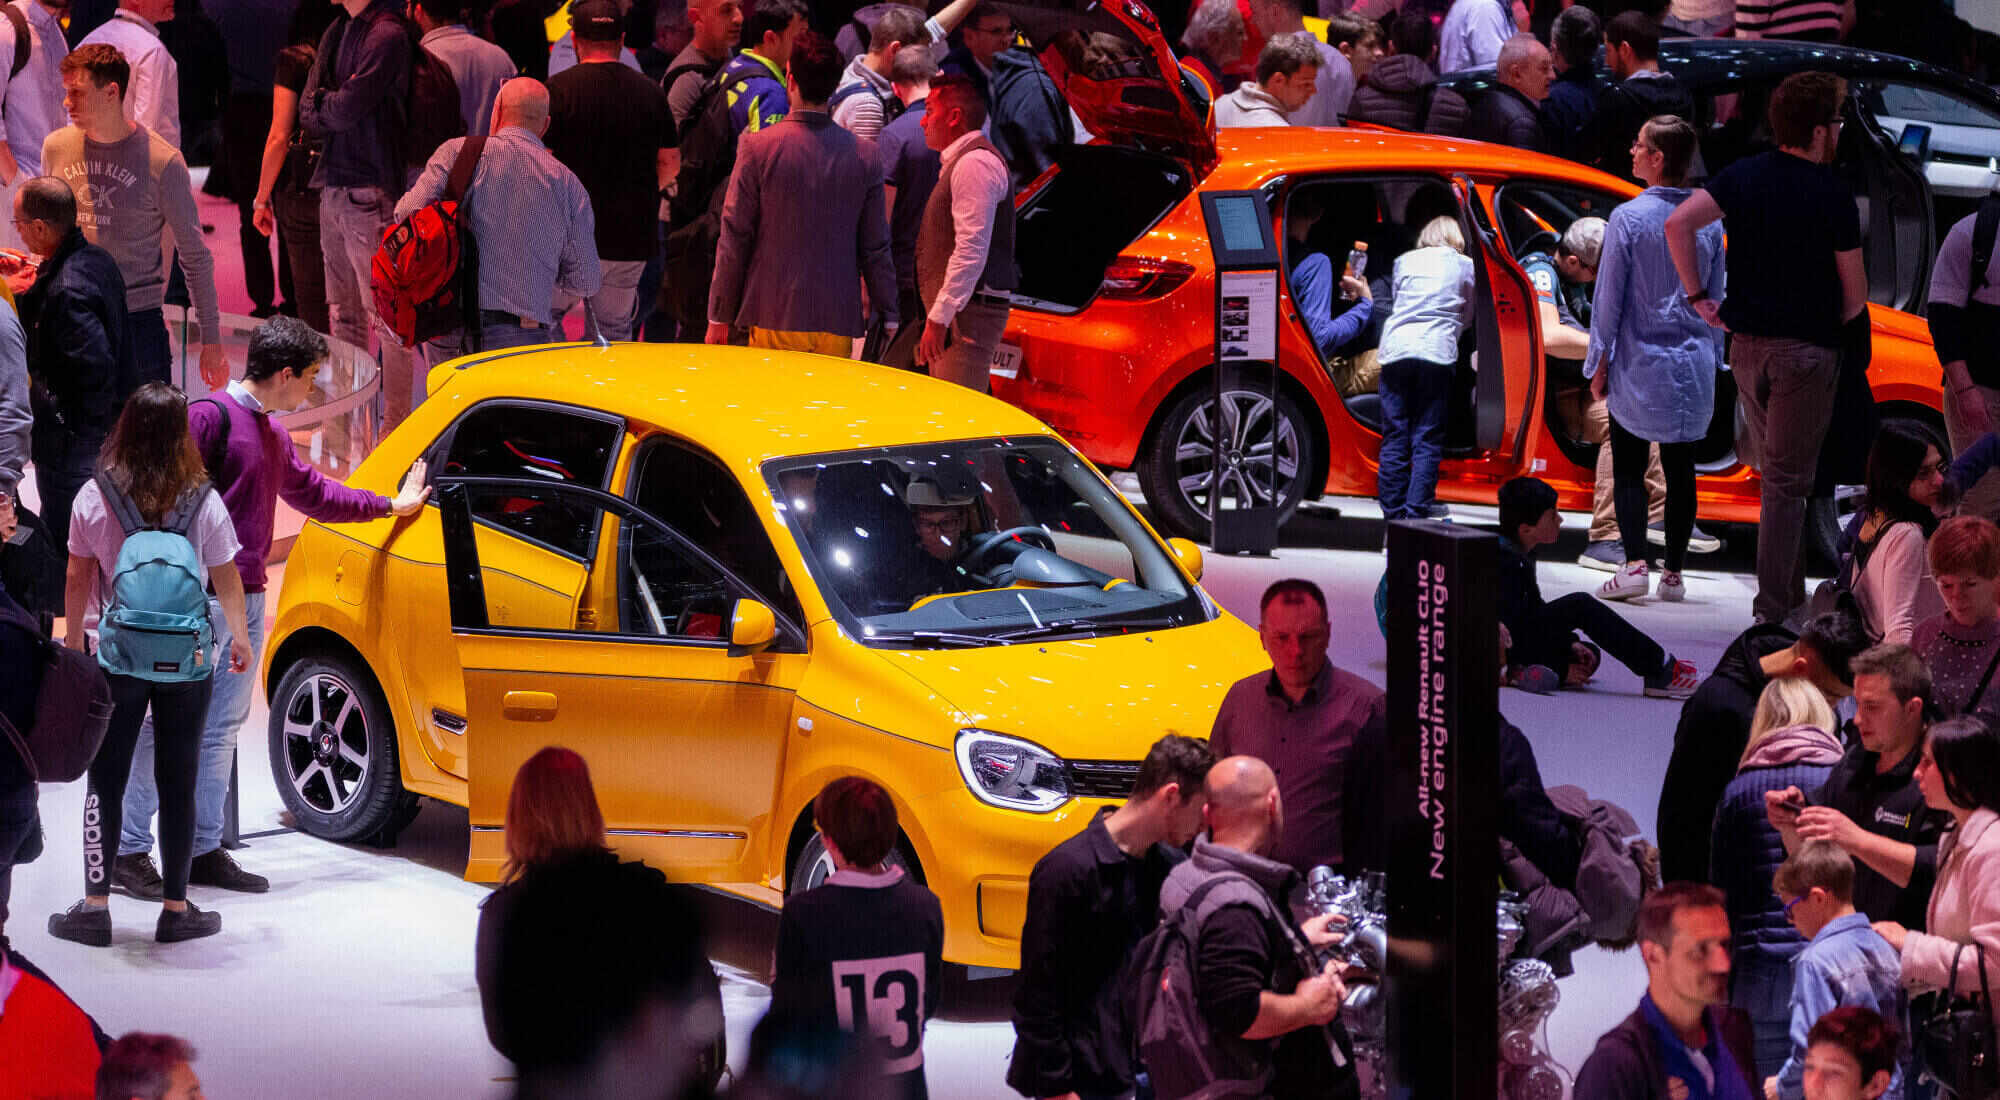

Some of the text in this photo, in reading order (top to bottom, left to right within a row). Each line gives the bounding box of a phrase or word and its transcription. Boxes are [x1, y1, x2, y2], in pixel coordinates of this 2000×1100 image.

[63, 160, 137, 188] CALVIN KLEIN
[78, 183, 118, 208] CK
[92, 214, 112, 225] YORK
[992, 350, 1016, 369] ULT
[1418, 559, 1430, 819] All-new Renault CLIO
[1430, 563, 1449, 880] New engine range
[83, 793, 105, 884] adidas
[840, 968, 921, 1061] 13
